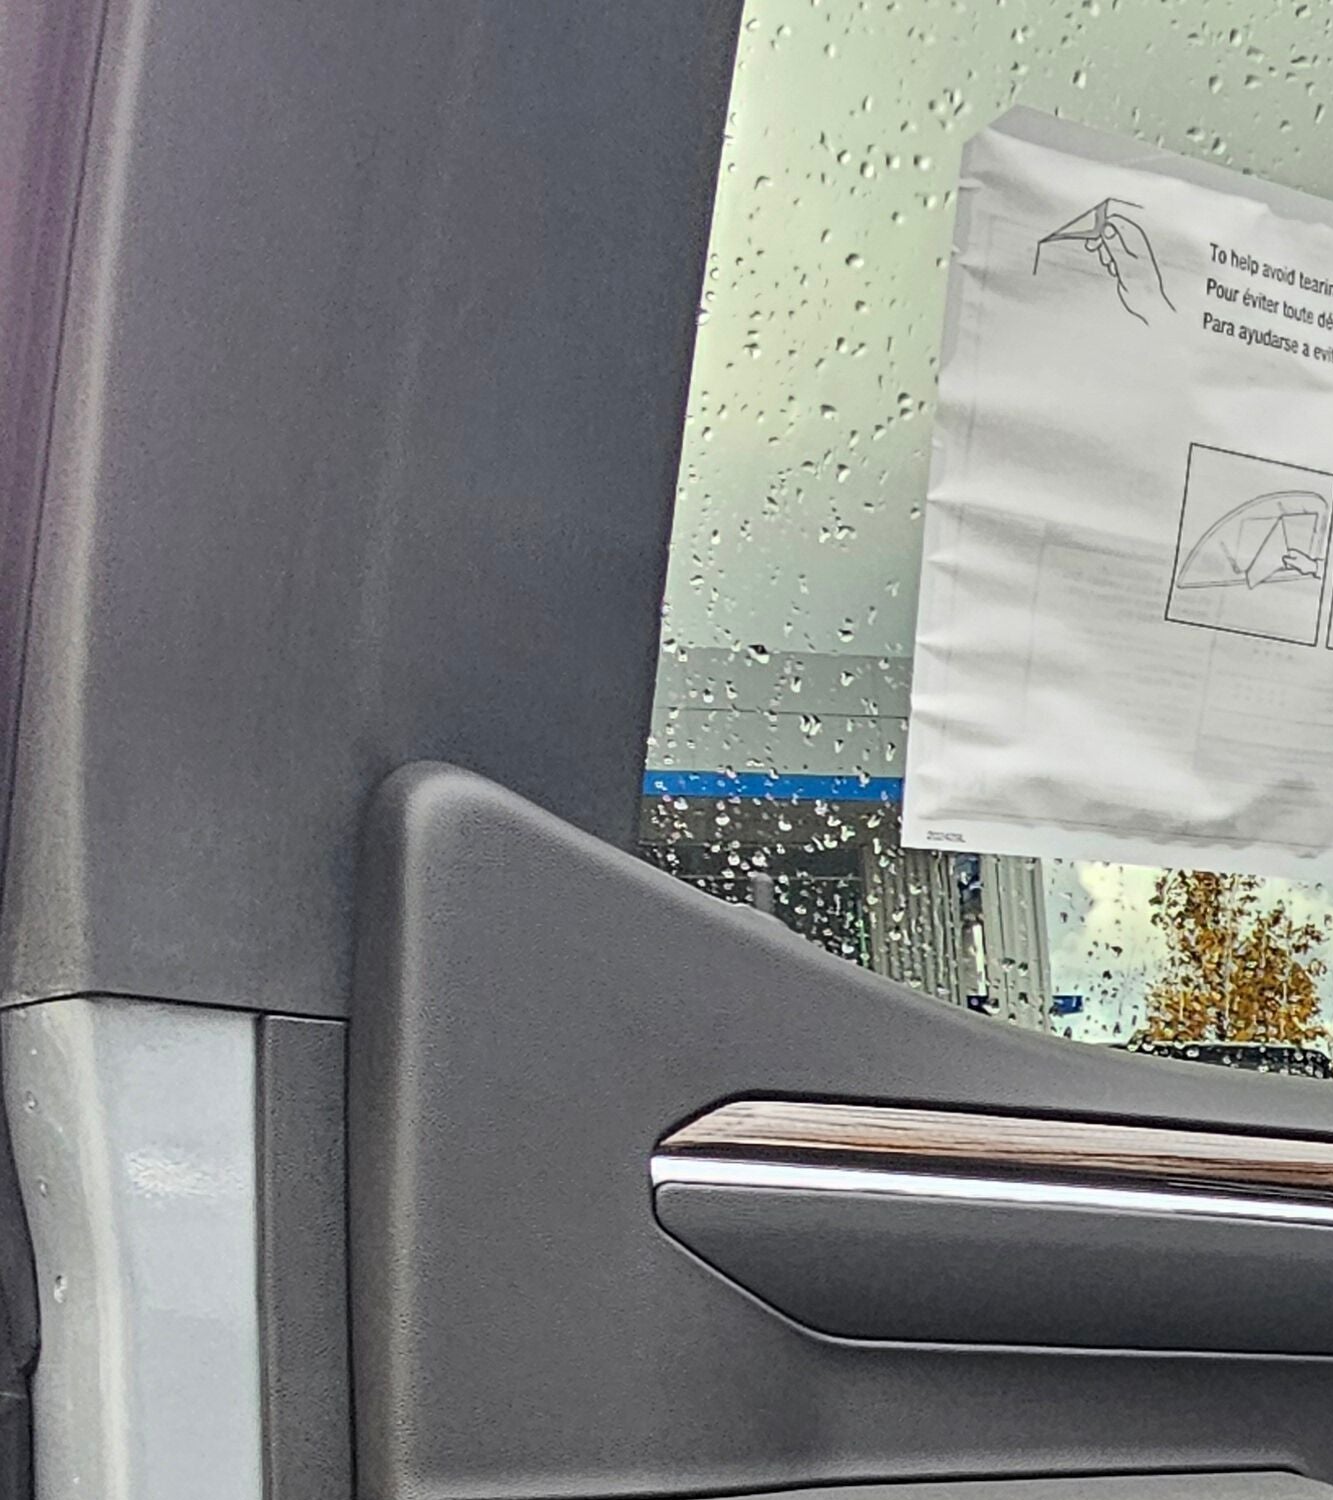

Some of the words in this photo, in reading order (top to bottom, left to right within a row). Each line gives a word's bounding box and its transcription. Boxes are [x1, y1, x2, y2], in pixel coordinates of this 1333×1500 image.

[1210, 242, 1227, 265] To
[1231, 249, 1258, 276] help
[1262, 262, 1295, 286] avoid
[1206, 278, 1239, 303] Pour
[1243, 287, 1279, 314] éviter
[1283, 300, 1314, 326] toute
[1203, 312, 1235, 337] Para
[1238, 325, 1299, 355] ayudarse
[1302, 342, 1310, 358] a
